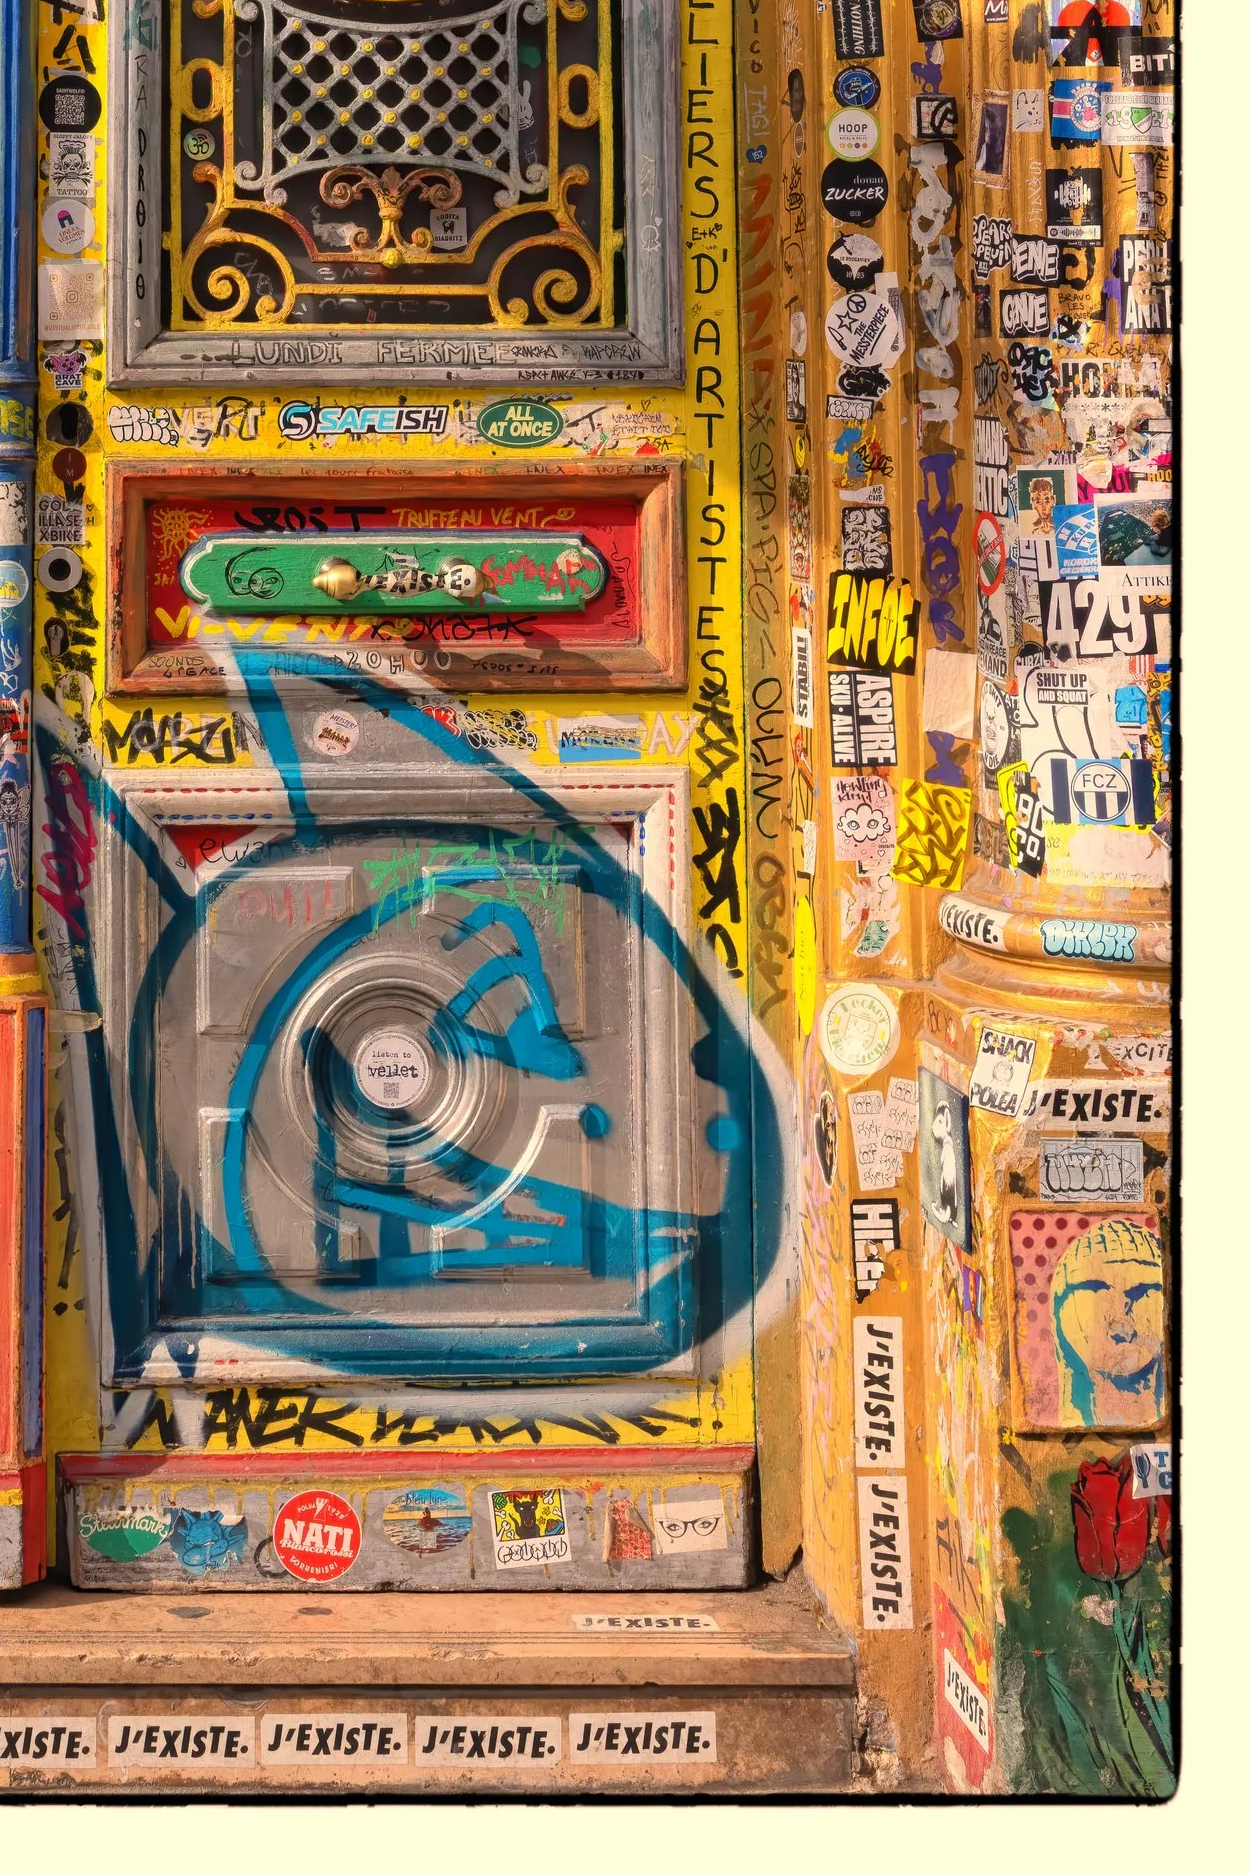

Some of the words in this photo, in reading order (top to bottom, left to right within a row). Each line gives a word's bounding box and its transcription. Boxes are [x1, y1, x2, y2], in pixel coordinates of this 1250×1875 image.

[847, 2, 866, 55] NOTHING
[838, 122, 868, 133] HOOP
[57, 188, 88, 196] TATTOO
[825, 186, 885, 202] ZUCKER
[233, 340, 345, 365] LUNDI
[320, 406, 447, 434] SAFEISH
[506, 406, 531, 420] ALL
[488, 422, 505, 437] AT
[509, 421, 552, 437] ONCE
[1036, 672, 1060, 688] SHUT
[1063, 672, 1088, 688] UP
[1038, 689, 1058, 703] AND
[1060, 689, 1088, 704] SQUAT
[857, 673, 892, 764] ASPIRE
[1082, 773, 1117, 789] FCZ
[372, 1050, 399, 1058] listen
[982, 1030, 1034, 1064] SNACK
[1024, 1090, 1163, 1122] J'EXISTE.
[867, 1323, 894, 1462] J'EXISTE.
[283, 1518, 353, 1551] NATI
[279, 1539, 354, 1559] Biancorossi
[870, 1484, 900, 1624] J'EXISTE.
[582, 1615, 712, 1629] J'EXISTE.
[114, 1723, 249, 1760] J'EXISTE.
[268, 1722, 402, 1757] J'EXISTE.
[422, 1723, 556, 1760] J'EXISTE.
[577, 1720, 711, 1754] J'EXISTE.
